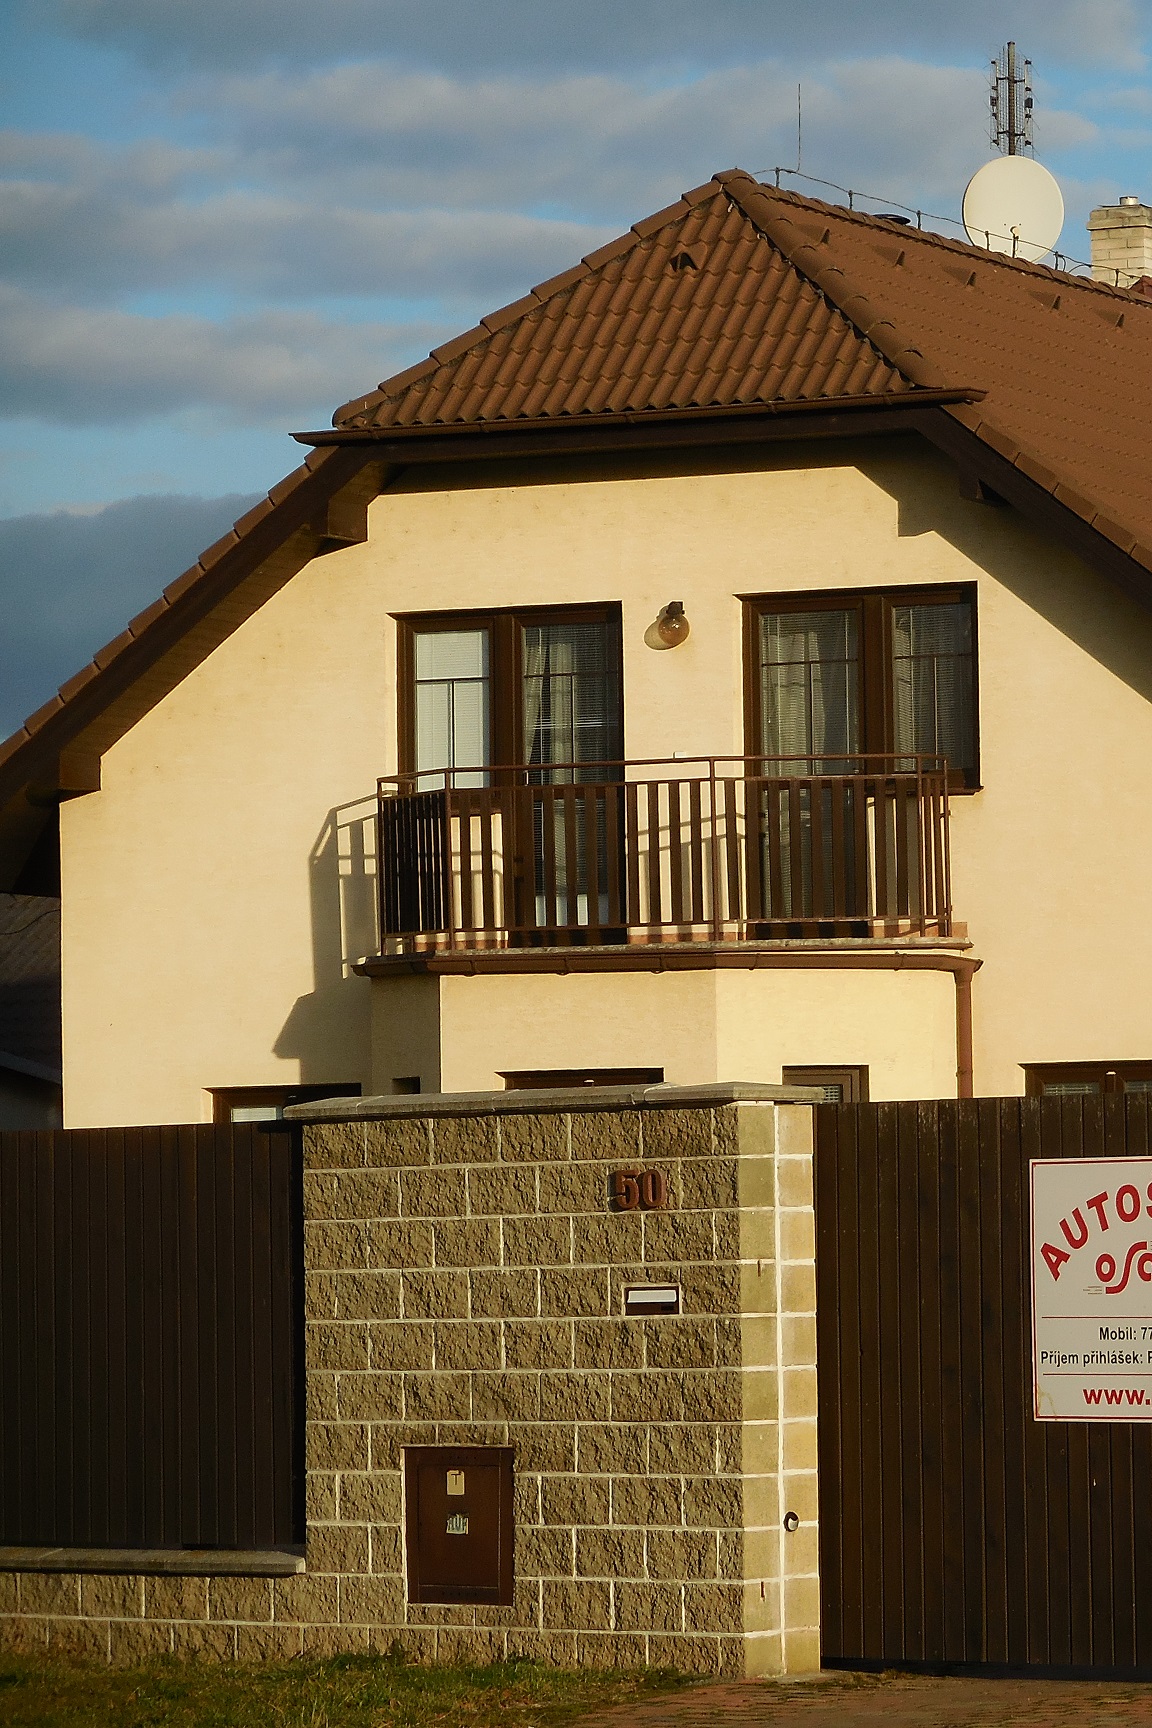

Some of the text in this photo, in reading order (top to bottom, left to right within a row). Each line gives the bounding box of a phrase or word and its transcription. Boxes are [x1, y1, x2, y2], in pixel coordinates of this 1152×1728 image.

[616, 1169, 667, 1209] 50
[1099, 1326, 1137, 1340] Mobil:
[1040, 1350, 1079, 1367] Příjem
[1083, 1350, 1143, 1367] přihlášek:
